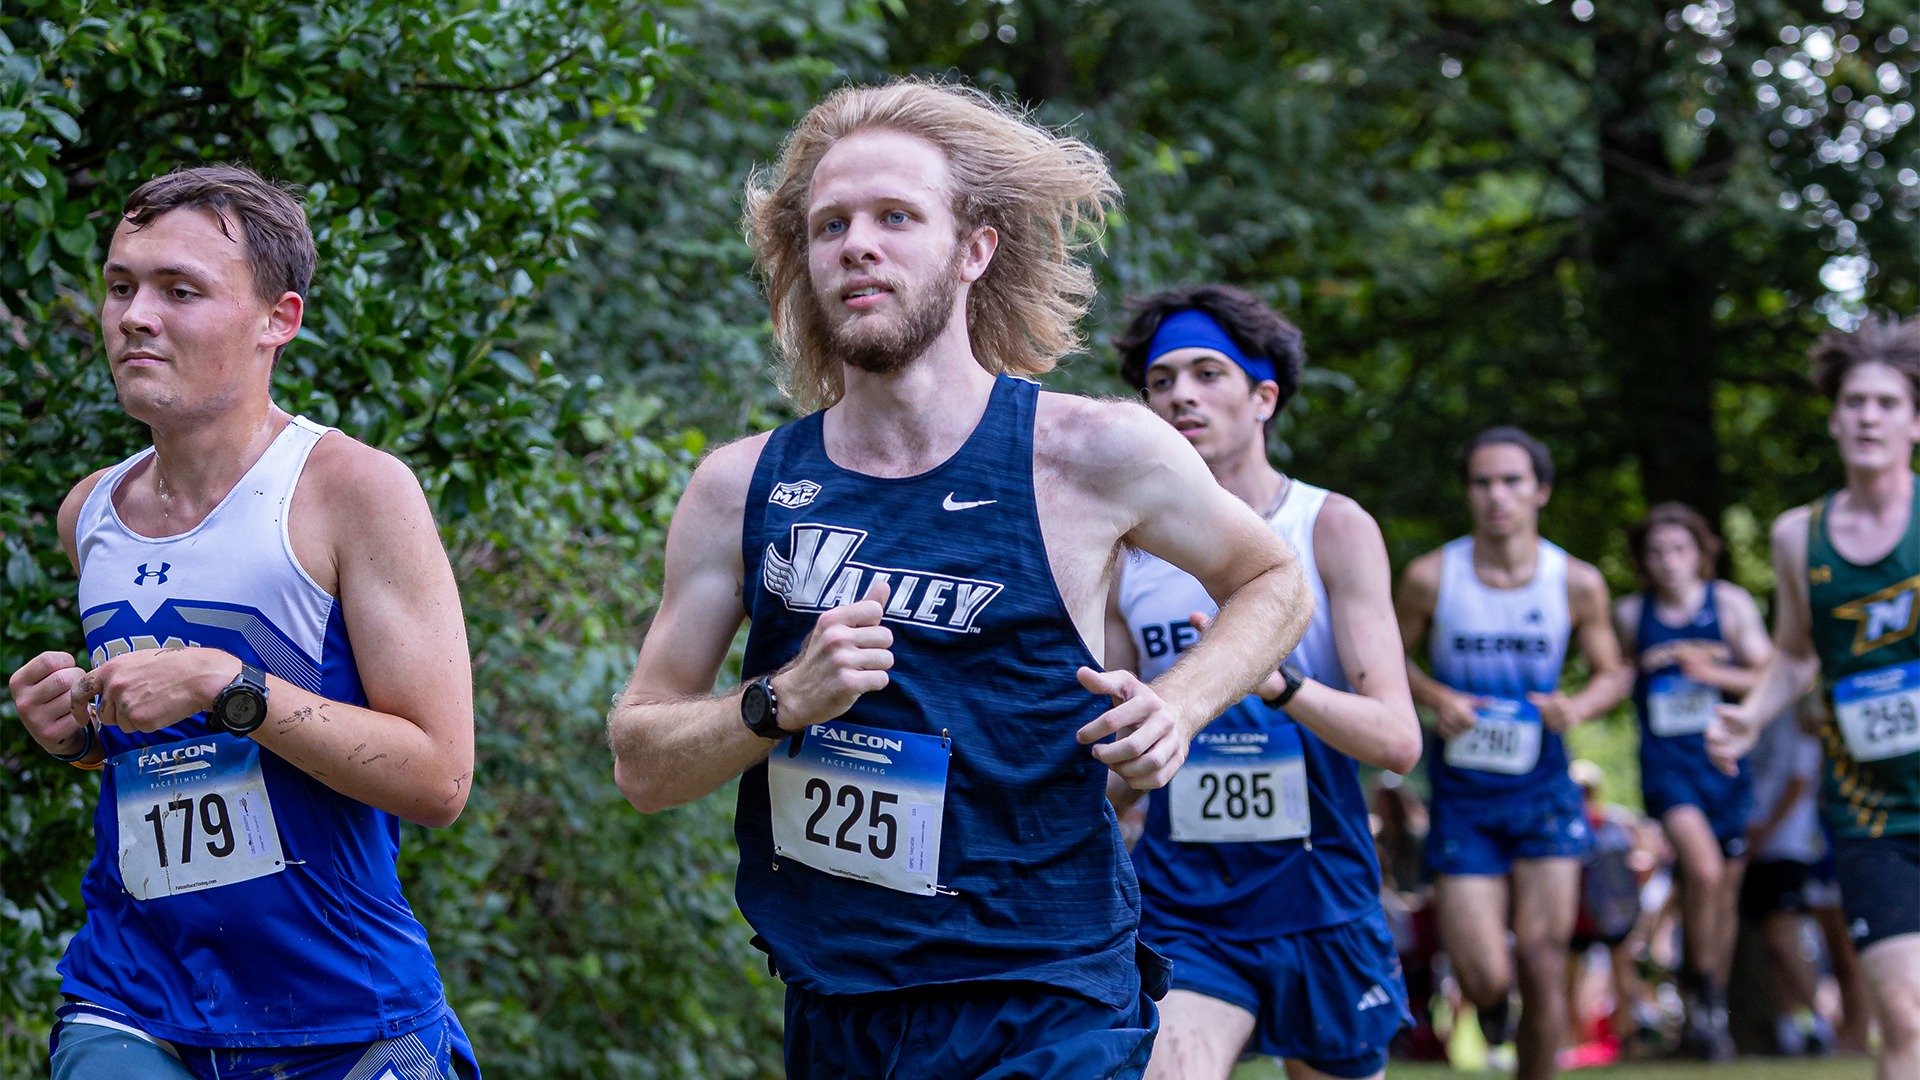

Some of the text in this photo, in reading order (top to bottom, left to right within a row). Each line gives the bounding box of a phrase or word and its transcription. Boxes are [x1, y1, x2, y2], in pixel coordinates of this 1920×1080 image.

[773, 489, 814, 506] MAC
[1864, 588, 1915, 642] N
[811, 724, 903, 752] FALCON
[1198, 733, 1269, 744] FALCON
[138, 742, 217, 767] FALCON
[821, 757, 886, 775] RACE TIMING
[150, 773, 208, 789] RACE TIMING
[1200, 773, 1275, 819] 285
[144, 793, 236, 868] 179
[805, 777, 898, 860] 225
